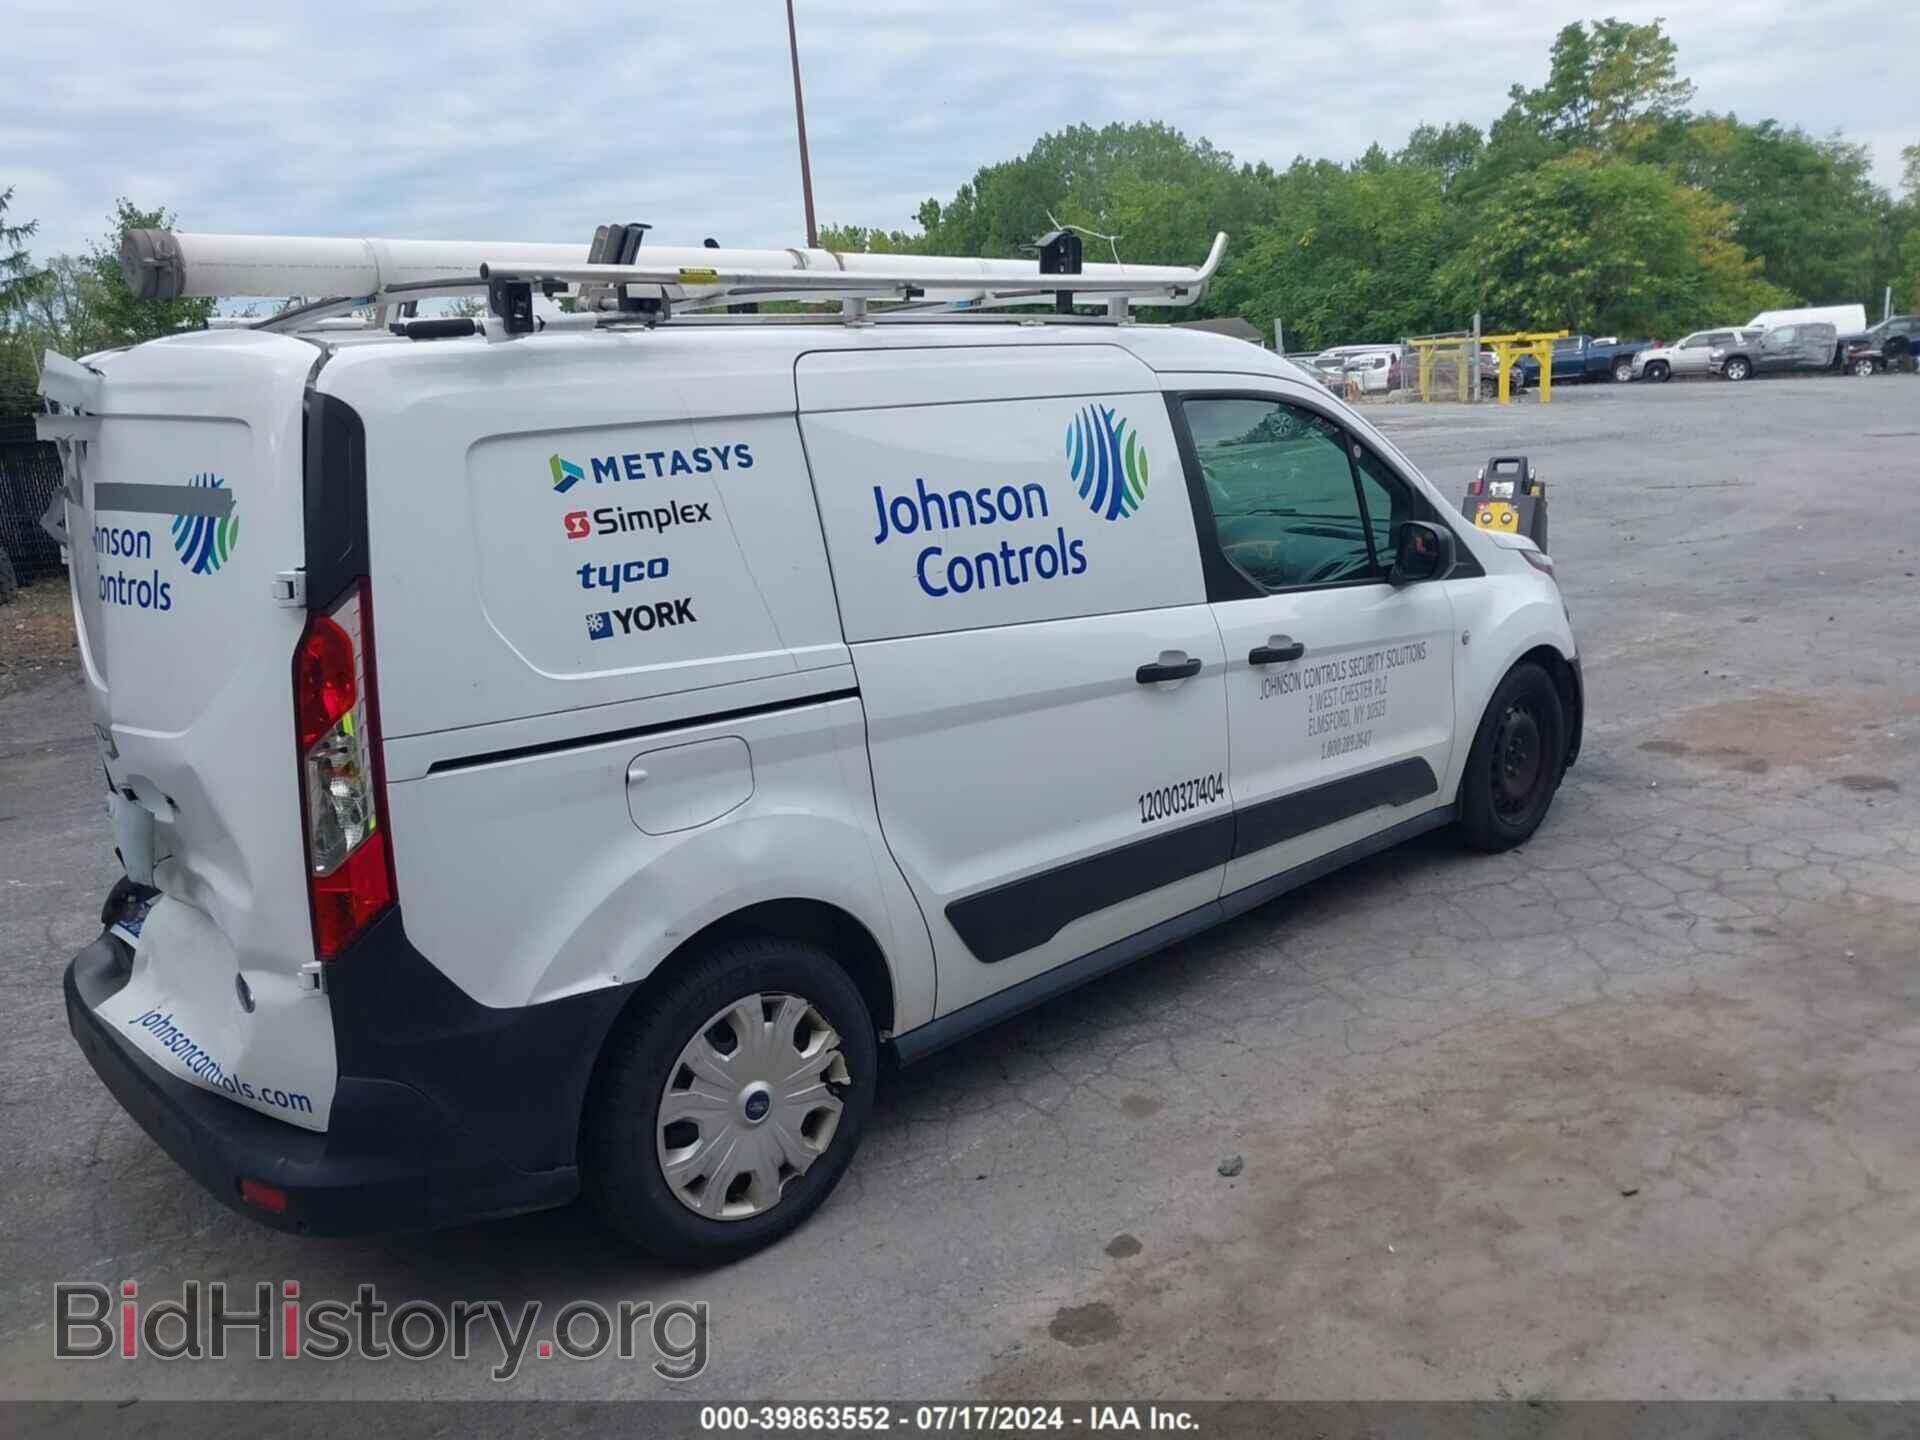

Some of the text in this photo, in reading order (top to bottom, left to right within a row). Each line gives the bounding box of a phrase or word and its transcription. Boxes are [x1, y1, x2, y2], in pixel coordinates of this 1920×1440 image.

[590, 443, 754, 484] METASYS
[593, 499, 713, 535] Simplex
[872, 477, 1049, 545] Johnson
[576, 556, 670, 594] tyco
[916, 526, 1088, 598] Controls
[98, 568, 172, 612] ontrols
[611, 597, 697, 635] YORK
[1259, 640, 1427, 701] JOHNSON CONTROLS SECURITY SOLUTIONS
[1315, 685, 1339, 711] WEST
[1138, 771, 1225, 824] 12000327404
[128, 1004, 313, 1114] johnsoncontrols.com
